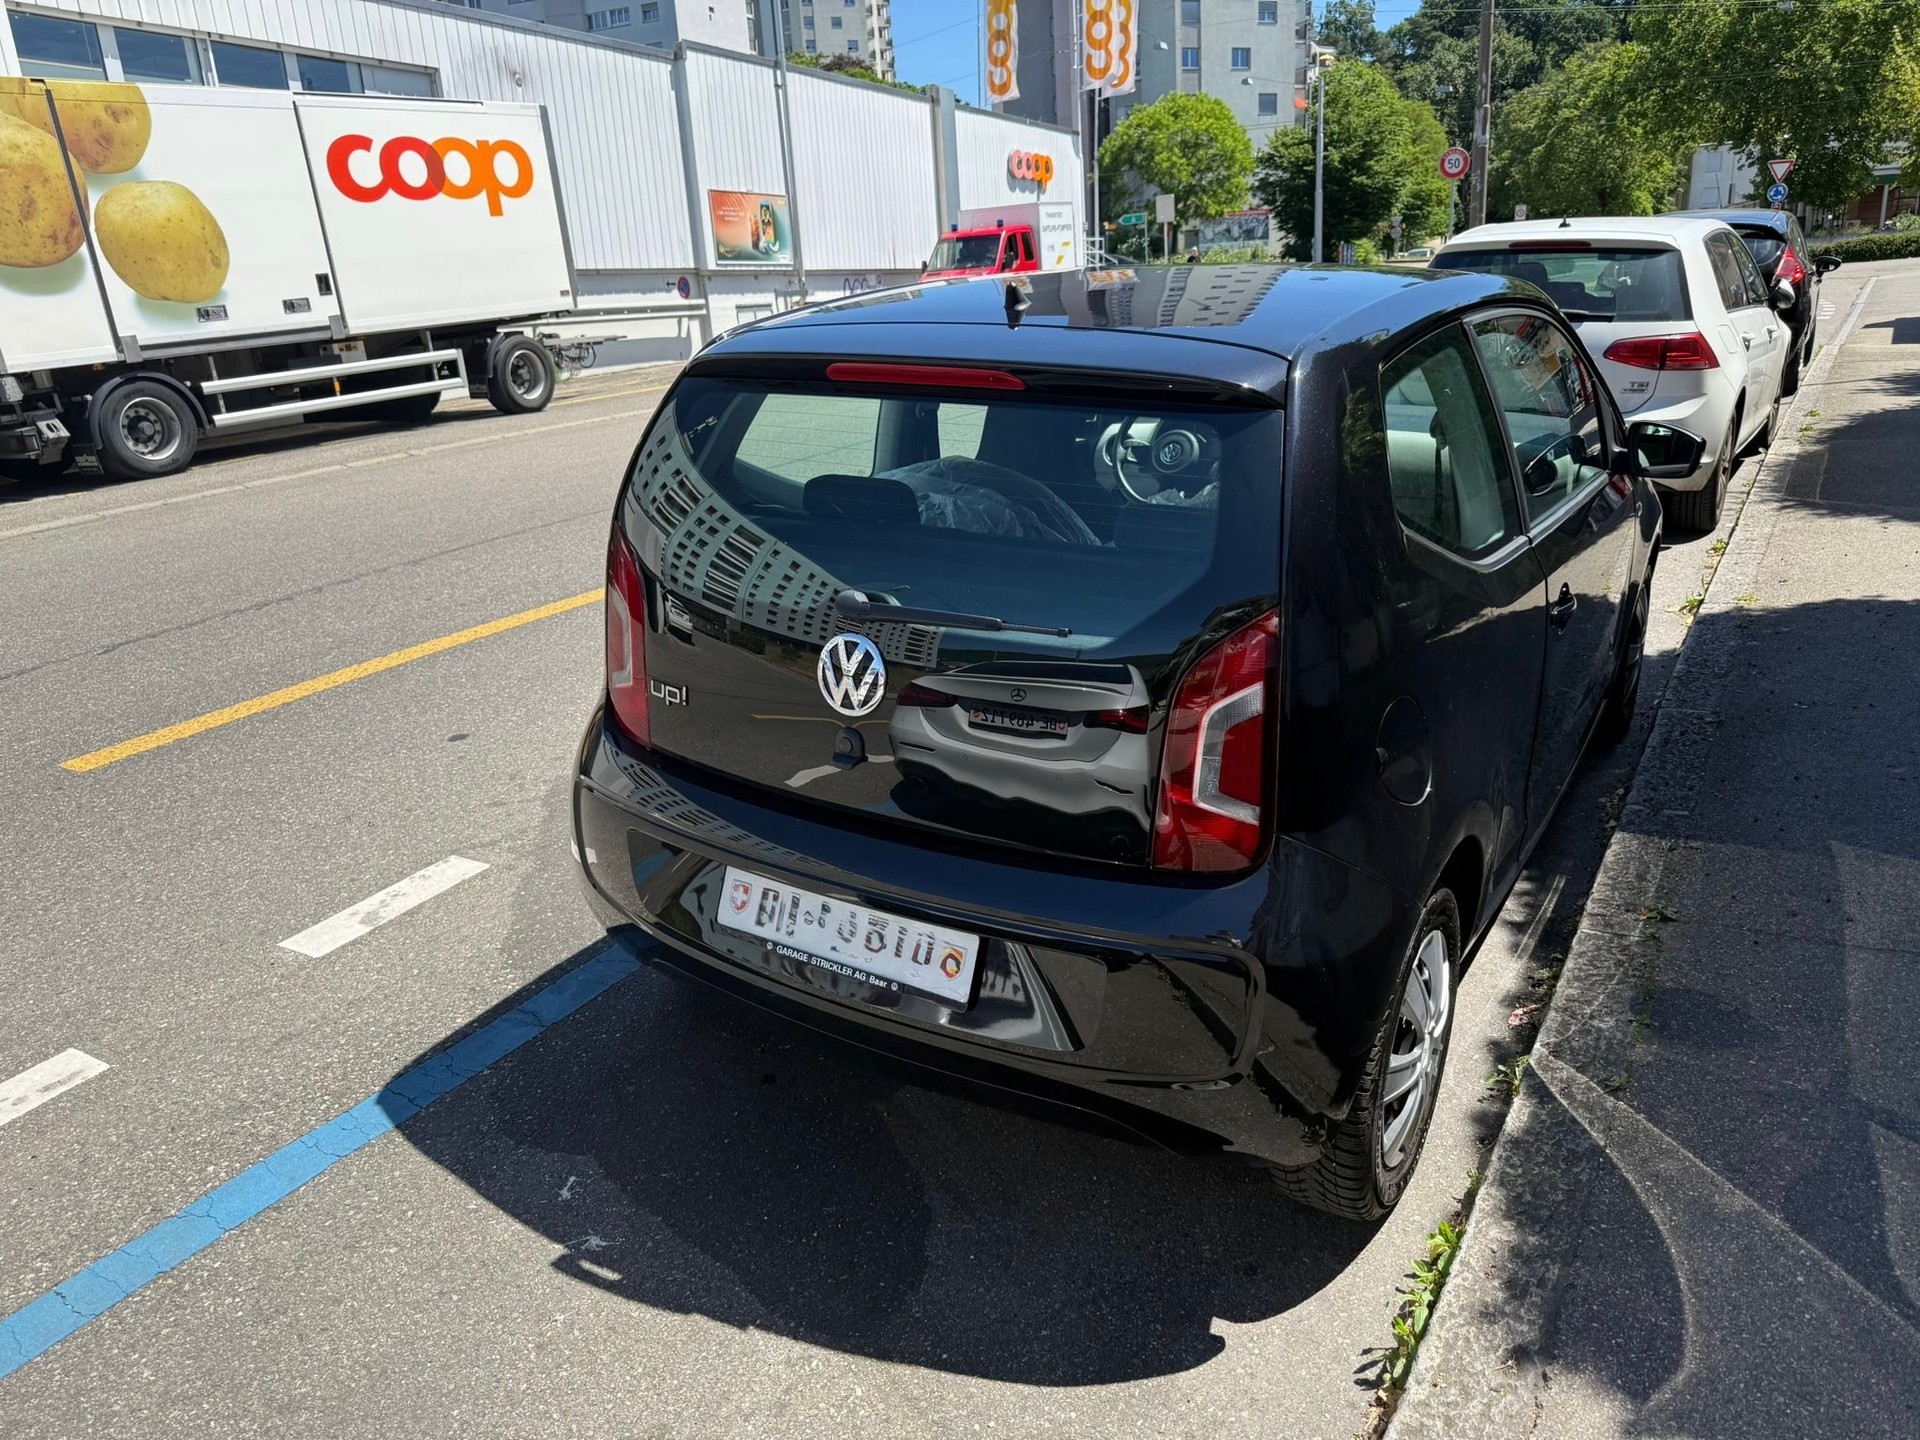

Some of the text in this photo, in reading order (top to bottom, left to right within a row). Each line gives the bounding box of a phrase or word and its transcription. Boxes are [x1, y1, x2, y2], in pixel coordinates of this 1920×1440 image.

[987, 0, 1013, 96] coo
[326, 134, 534, 217] coop
[1012, 150, 1053, 190] coop
[1447, 158, 1461, 169] 50
[650, 678, 688, 706] up!
[776, 945, 888, 988] GARAGE STRICKLER AG Baar
